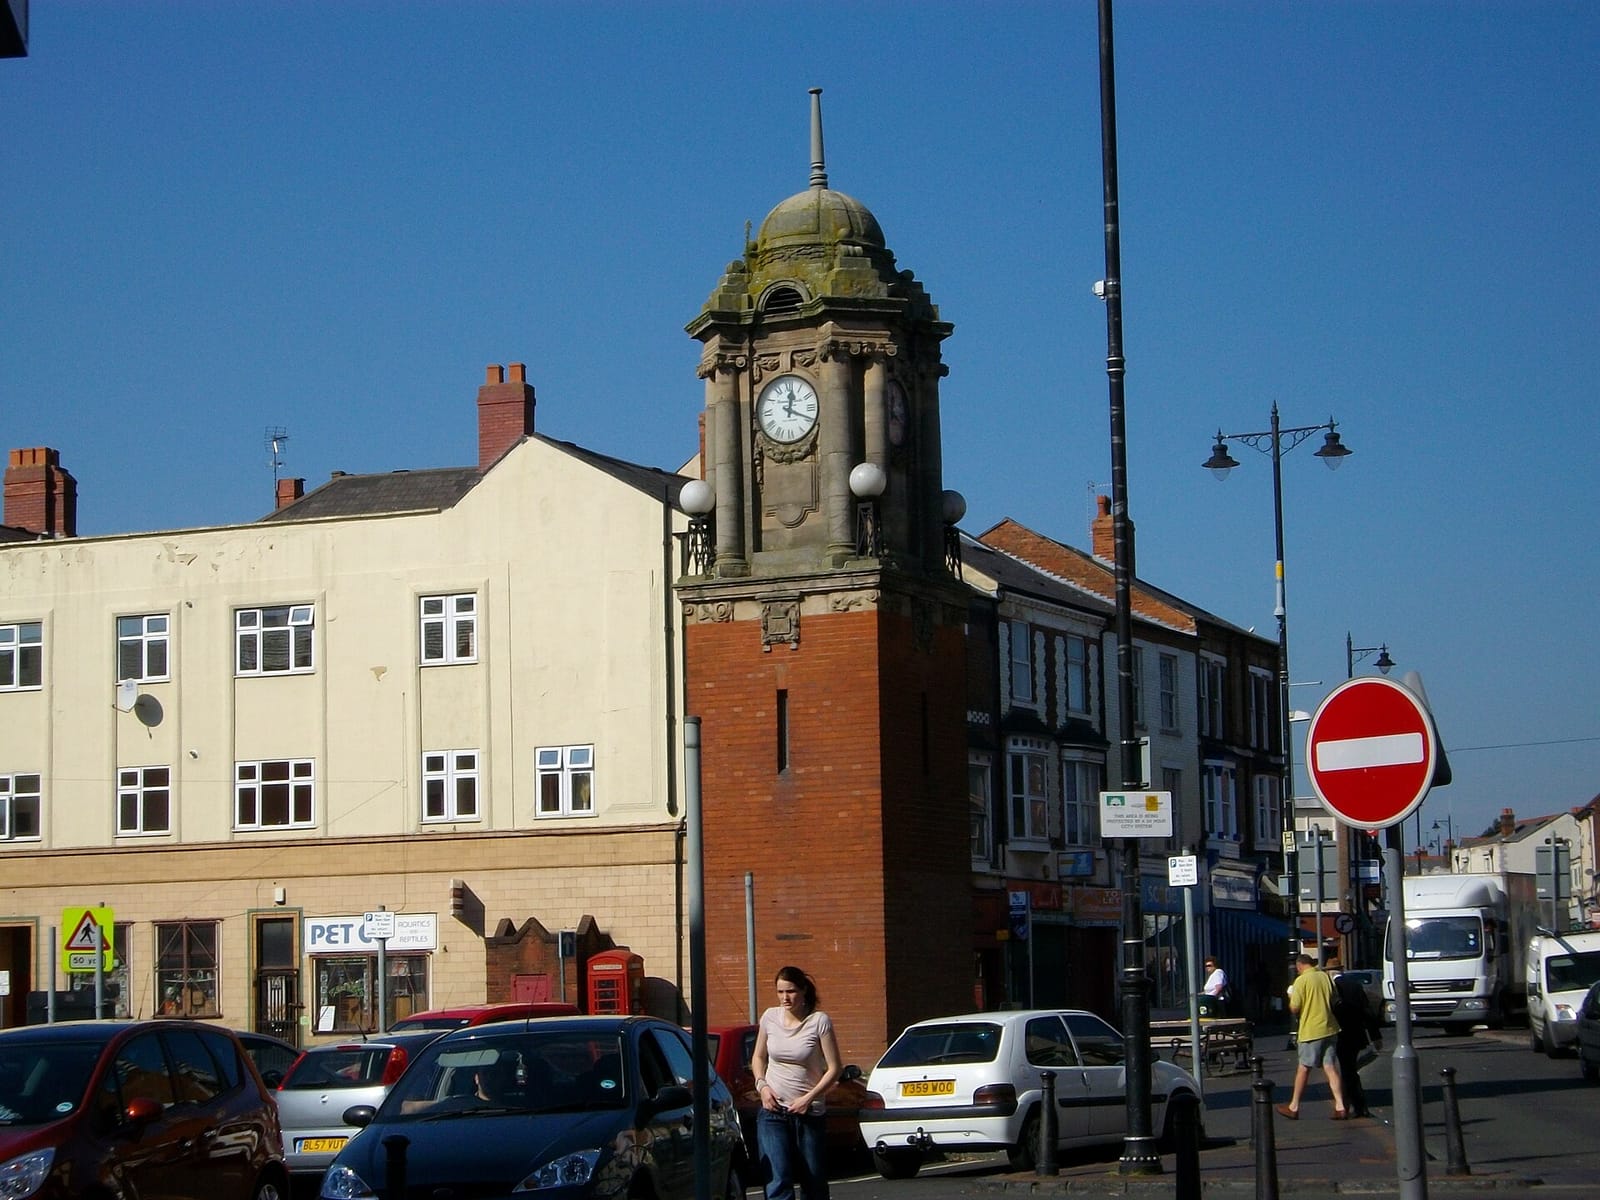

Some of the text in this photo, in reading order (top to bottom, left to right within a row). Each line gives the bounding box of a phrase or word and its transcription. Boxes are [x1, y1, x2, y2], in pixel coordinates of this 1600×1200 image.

[398, 919, 430, 928] AQUATICS
[311, 923, 354, 945] PET
[399, 934, 428, 943] REPTILES
[73, 956, 85, 965] 50
[903, 1083, 929, 1094] Y359
[303, 1141, 326, 1151] BL57
